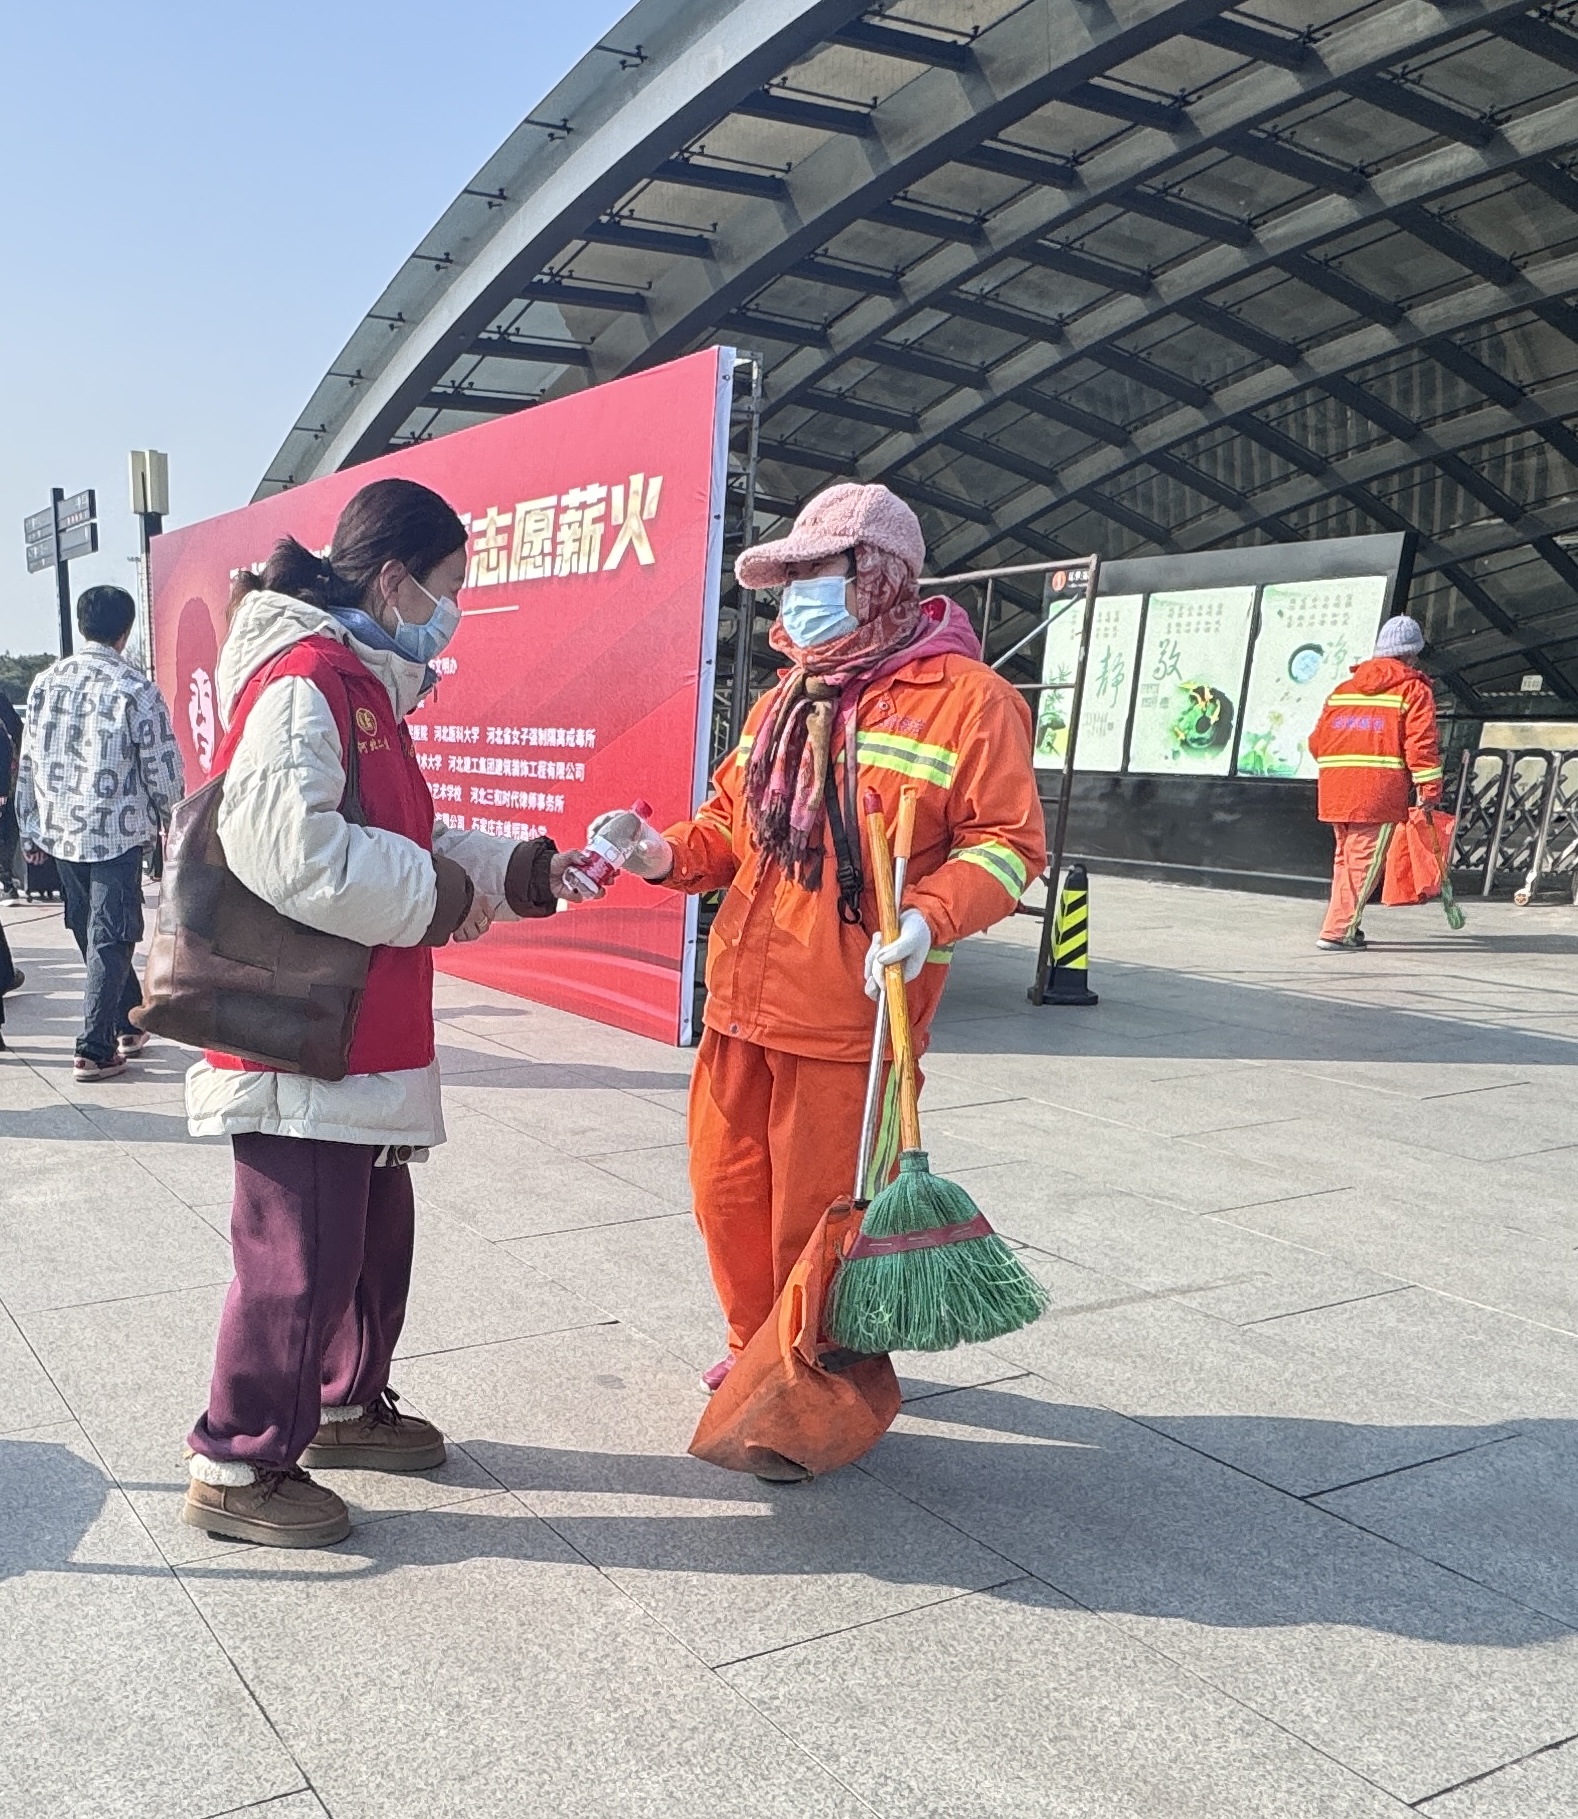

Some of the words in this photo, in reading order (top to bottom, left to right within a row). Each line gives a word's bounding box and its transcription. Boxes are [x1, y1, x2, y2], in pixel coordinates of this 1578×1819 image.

[462, 473, 663, 589] 志愿薪火
[1153, 639, 1182, 681] 敬
[433, 725, 480, 744] 河北医科大学
[486, 726, 596, 749] 河北省女子强制隔离戒毒所
[448, 755, 585, 782] 河北建工集团建筑装饰工程有限公司
[470, 786, 566, 813] 河北三和时代律师事务所
